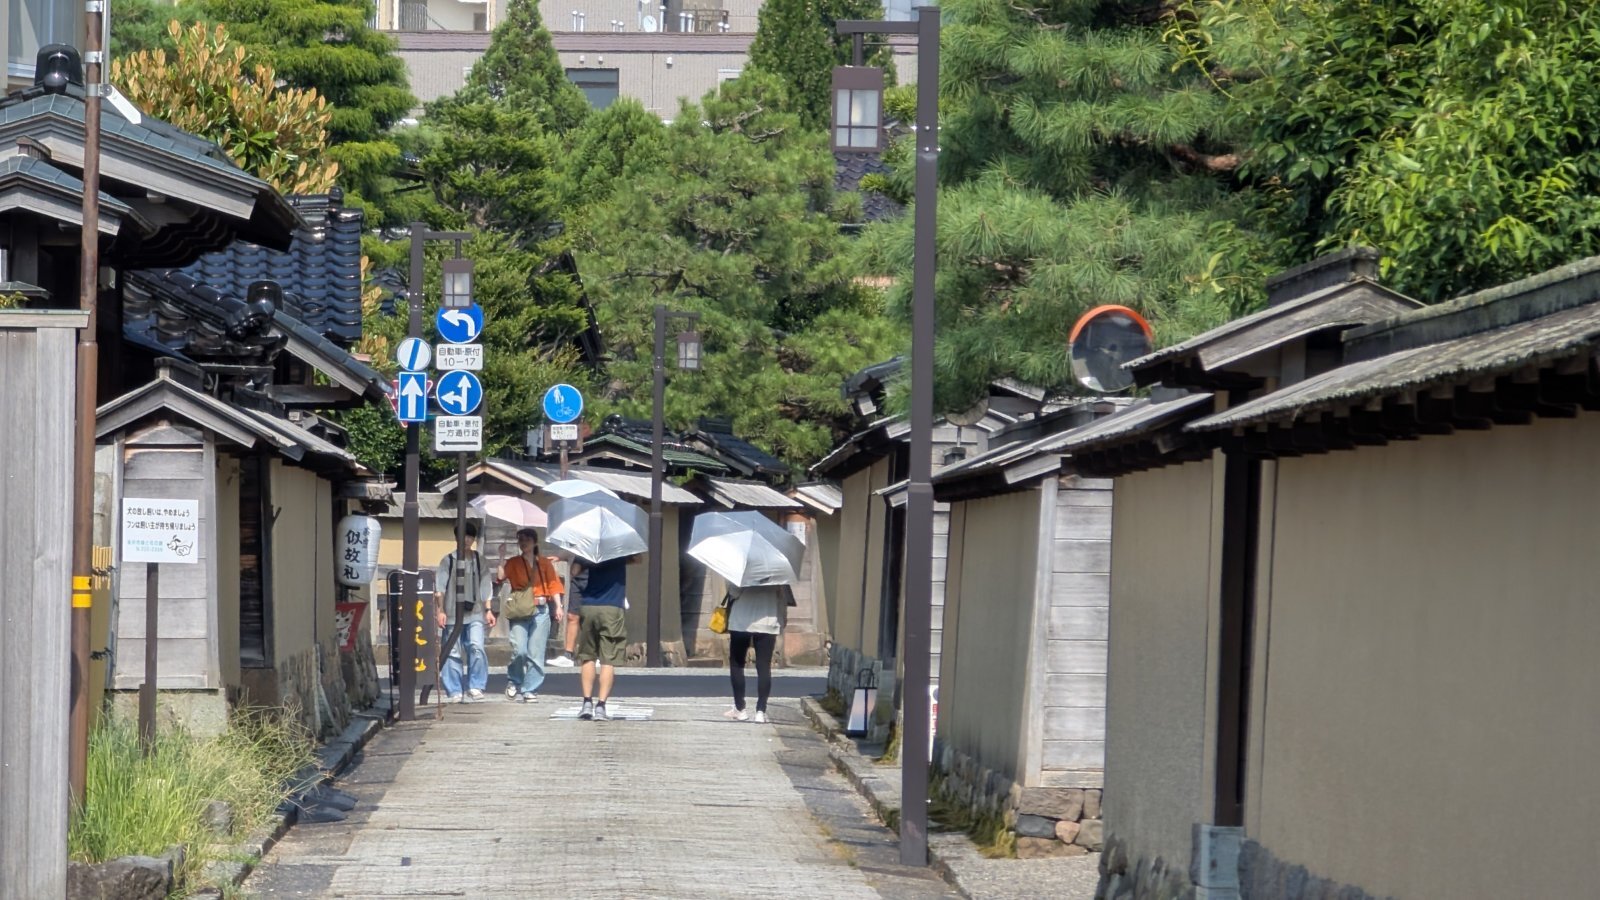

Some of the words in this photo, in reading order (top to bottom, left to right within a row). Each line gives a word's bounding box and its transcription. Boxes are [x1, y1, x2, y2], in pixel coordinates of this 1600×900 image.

[438, 347, 480, 356] 自動車・原付
[438, 429, 480, 438] 一方通行路
[343, 529, 362, 580] 似故礼
